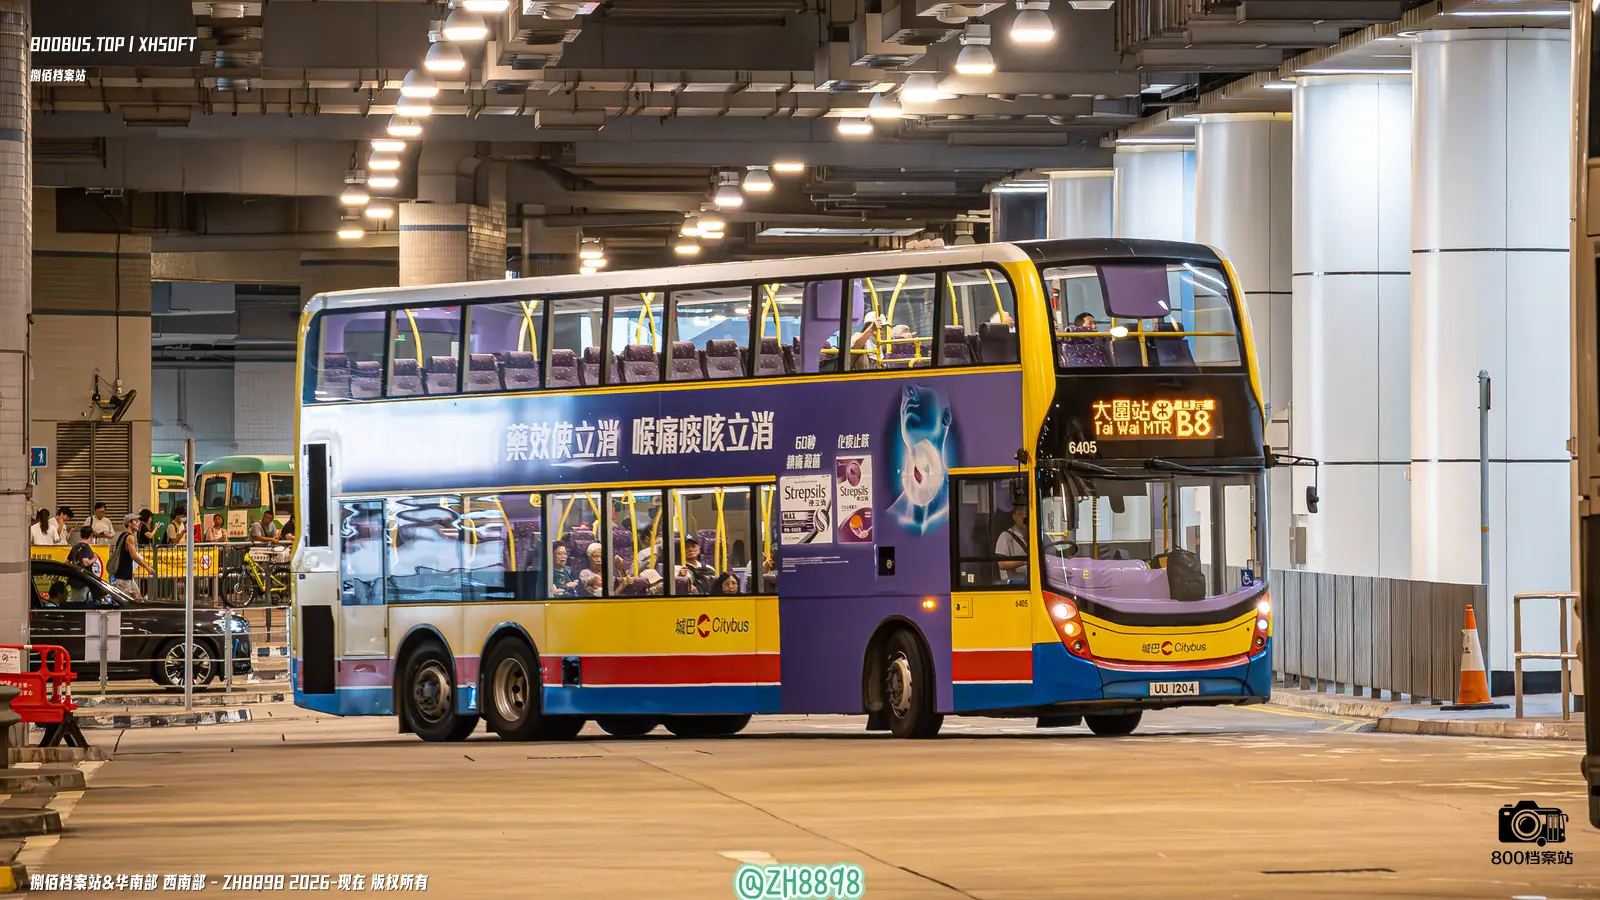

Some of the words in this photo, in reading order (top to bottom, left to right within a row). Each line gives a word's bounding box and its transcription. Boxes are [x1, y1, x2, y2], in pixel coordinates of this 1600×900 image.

[1093, 400, 1150, 421] 大圍站
[1095, 421, 1113, 436] Tai
[1117, 421, 1140, 436] Wai
[1144, 421, 1172, 435] MTR
[1177, 410, 1211, 437] B8
[506, 419, 619, 461] 藥效使立消
[632, 410, 775, 456] 喉痛痰咳立消
[795, 435, 817, 450] 60秒
[837, 433, 871, 449] 化痰止咳
[1068, 440, 1098, 455] 6405
[784, 484, 827, 503] Strepsils
[840, 486, 869, 498] Strepsils
[1015, 600, 1029, 608] 6405
[675, 618, 696, 635] 城巴
[712, 616, 749, 635] Citybus
[1174, 642, 1207, 653] Citybus
[1154, 683, 1169, 694] UU
[1172, 683, 1195, 694] 1204
